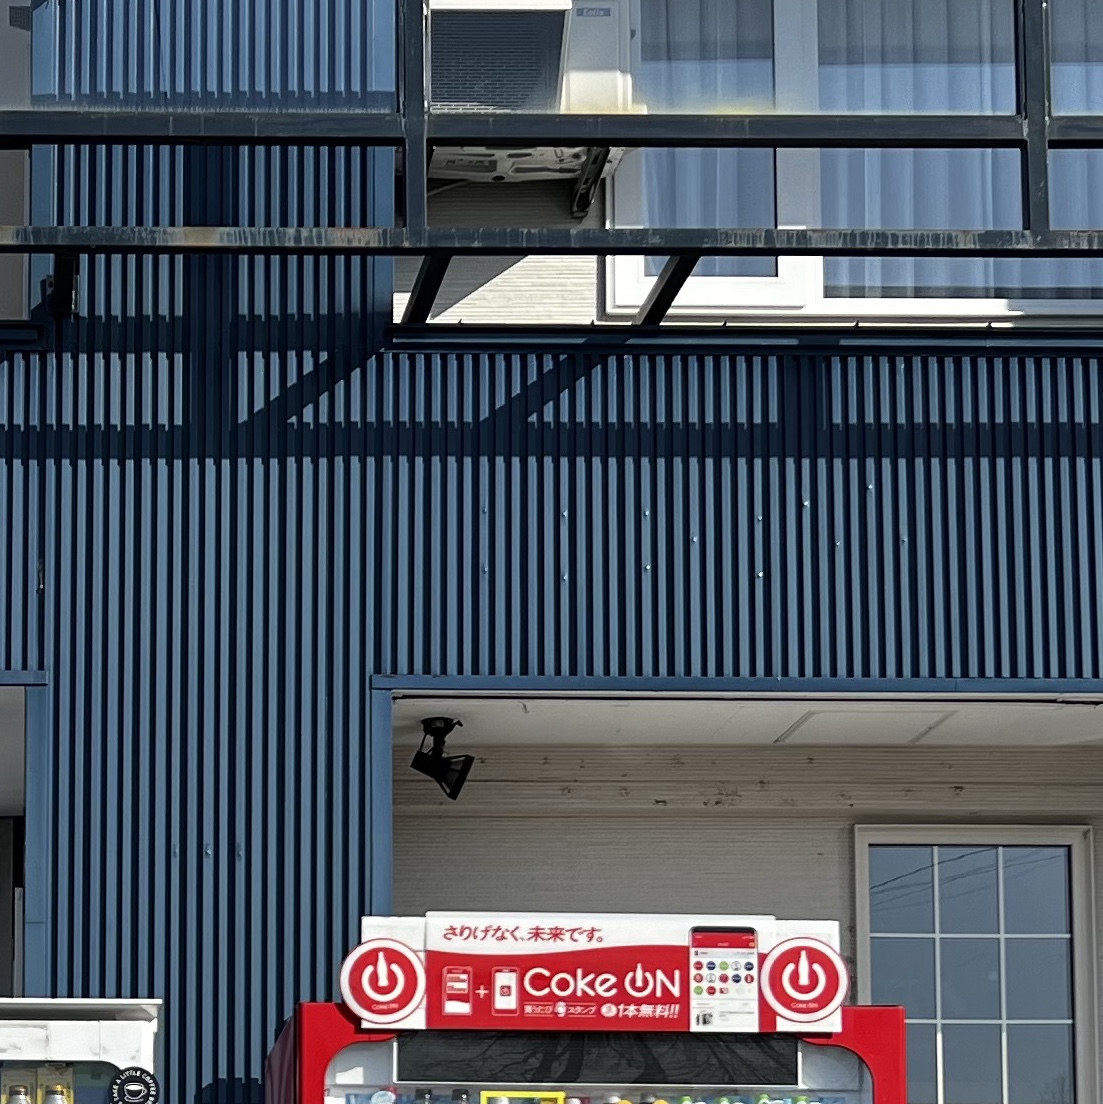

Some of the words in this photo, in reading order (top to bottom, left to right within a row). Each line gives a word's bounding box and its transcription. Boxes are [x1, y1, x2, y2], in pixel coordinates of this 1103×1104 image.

[442, 926, 604, 943] さりげなく、未来です。
[522, 967, 618, 998] Coke
[623, 962, 681, 998] ON
